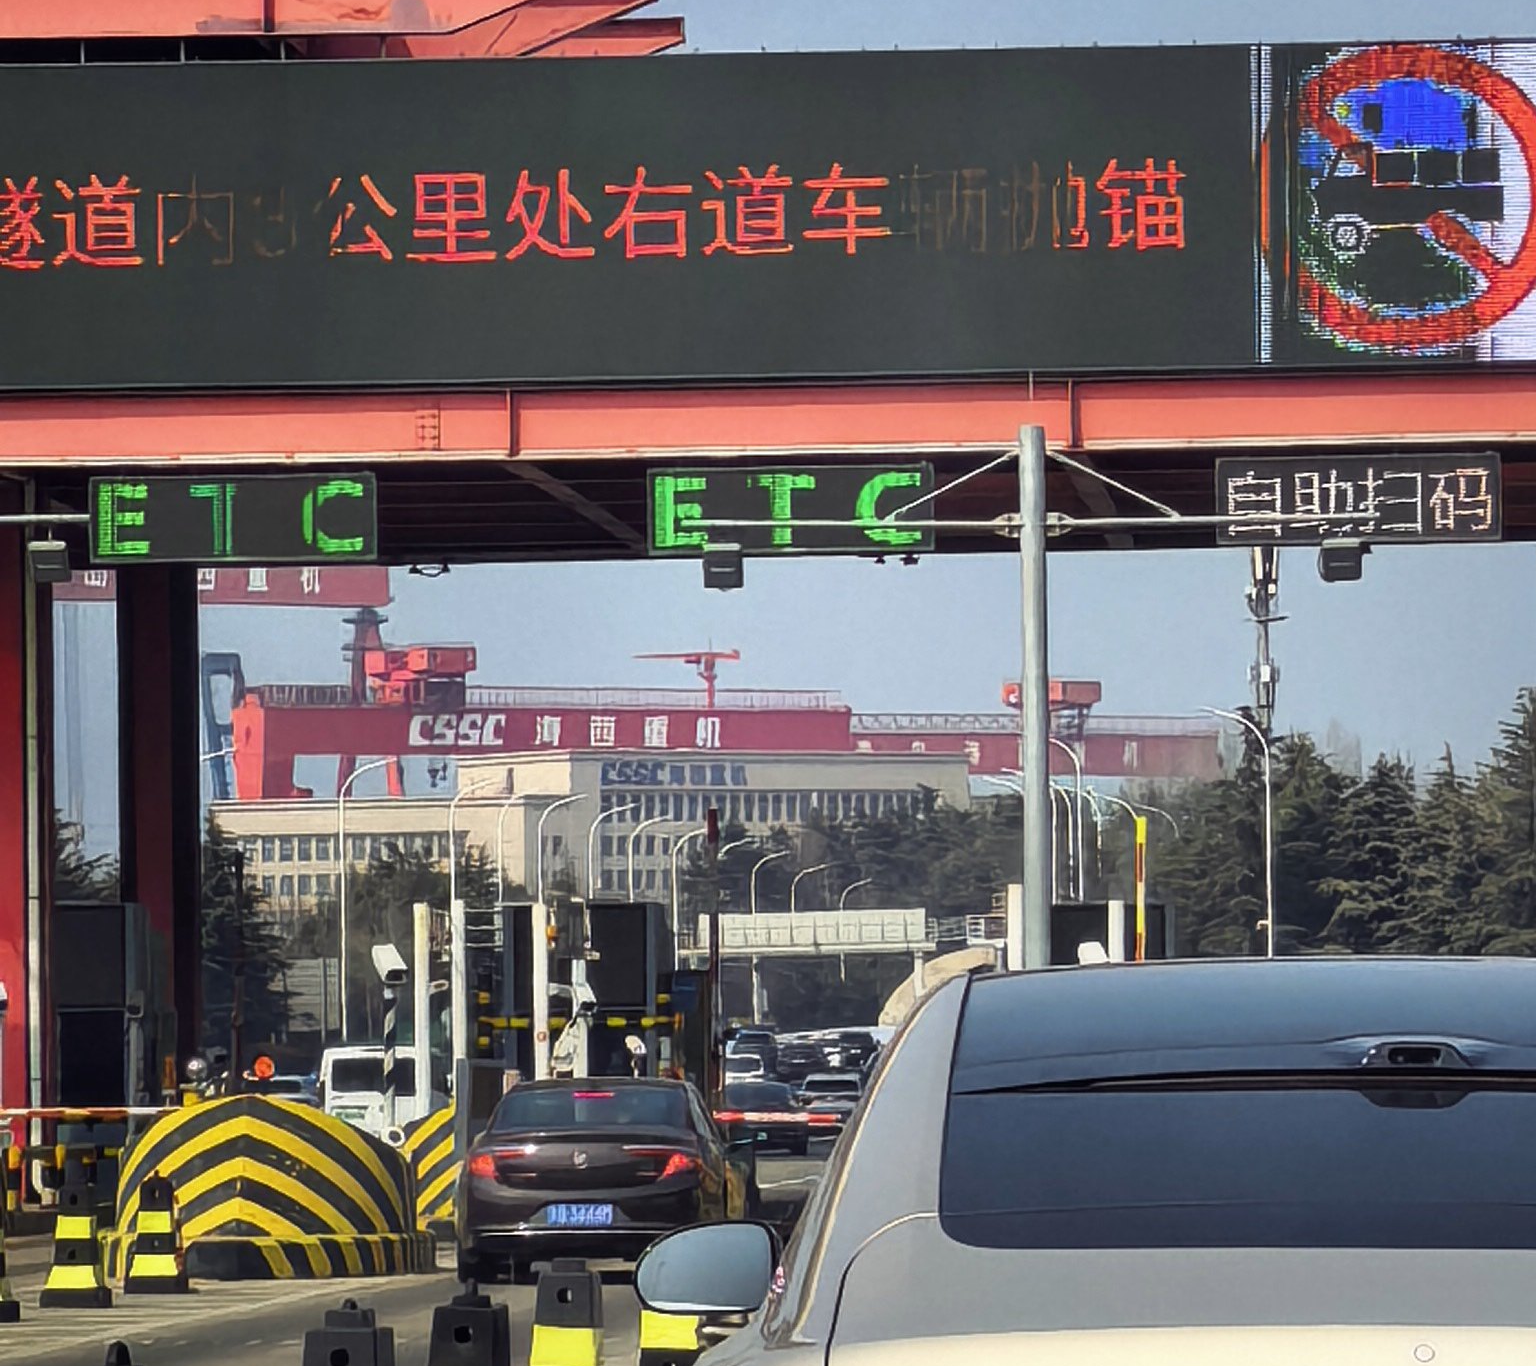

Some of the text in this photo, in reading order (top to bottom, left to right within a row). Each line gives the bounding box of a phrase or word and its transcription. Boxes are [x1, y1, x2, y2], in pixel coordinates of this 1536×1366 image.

[98, 480, 365, 556] ETC
[655, 471, 922, 548] ETC
[1226, 467, 1494, 537] 自助扫码
[408, 714, 507, 747] CSSC
